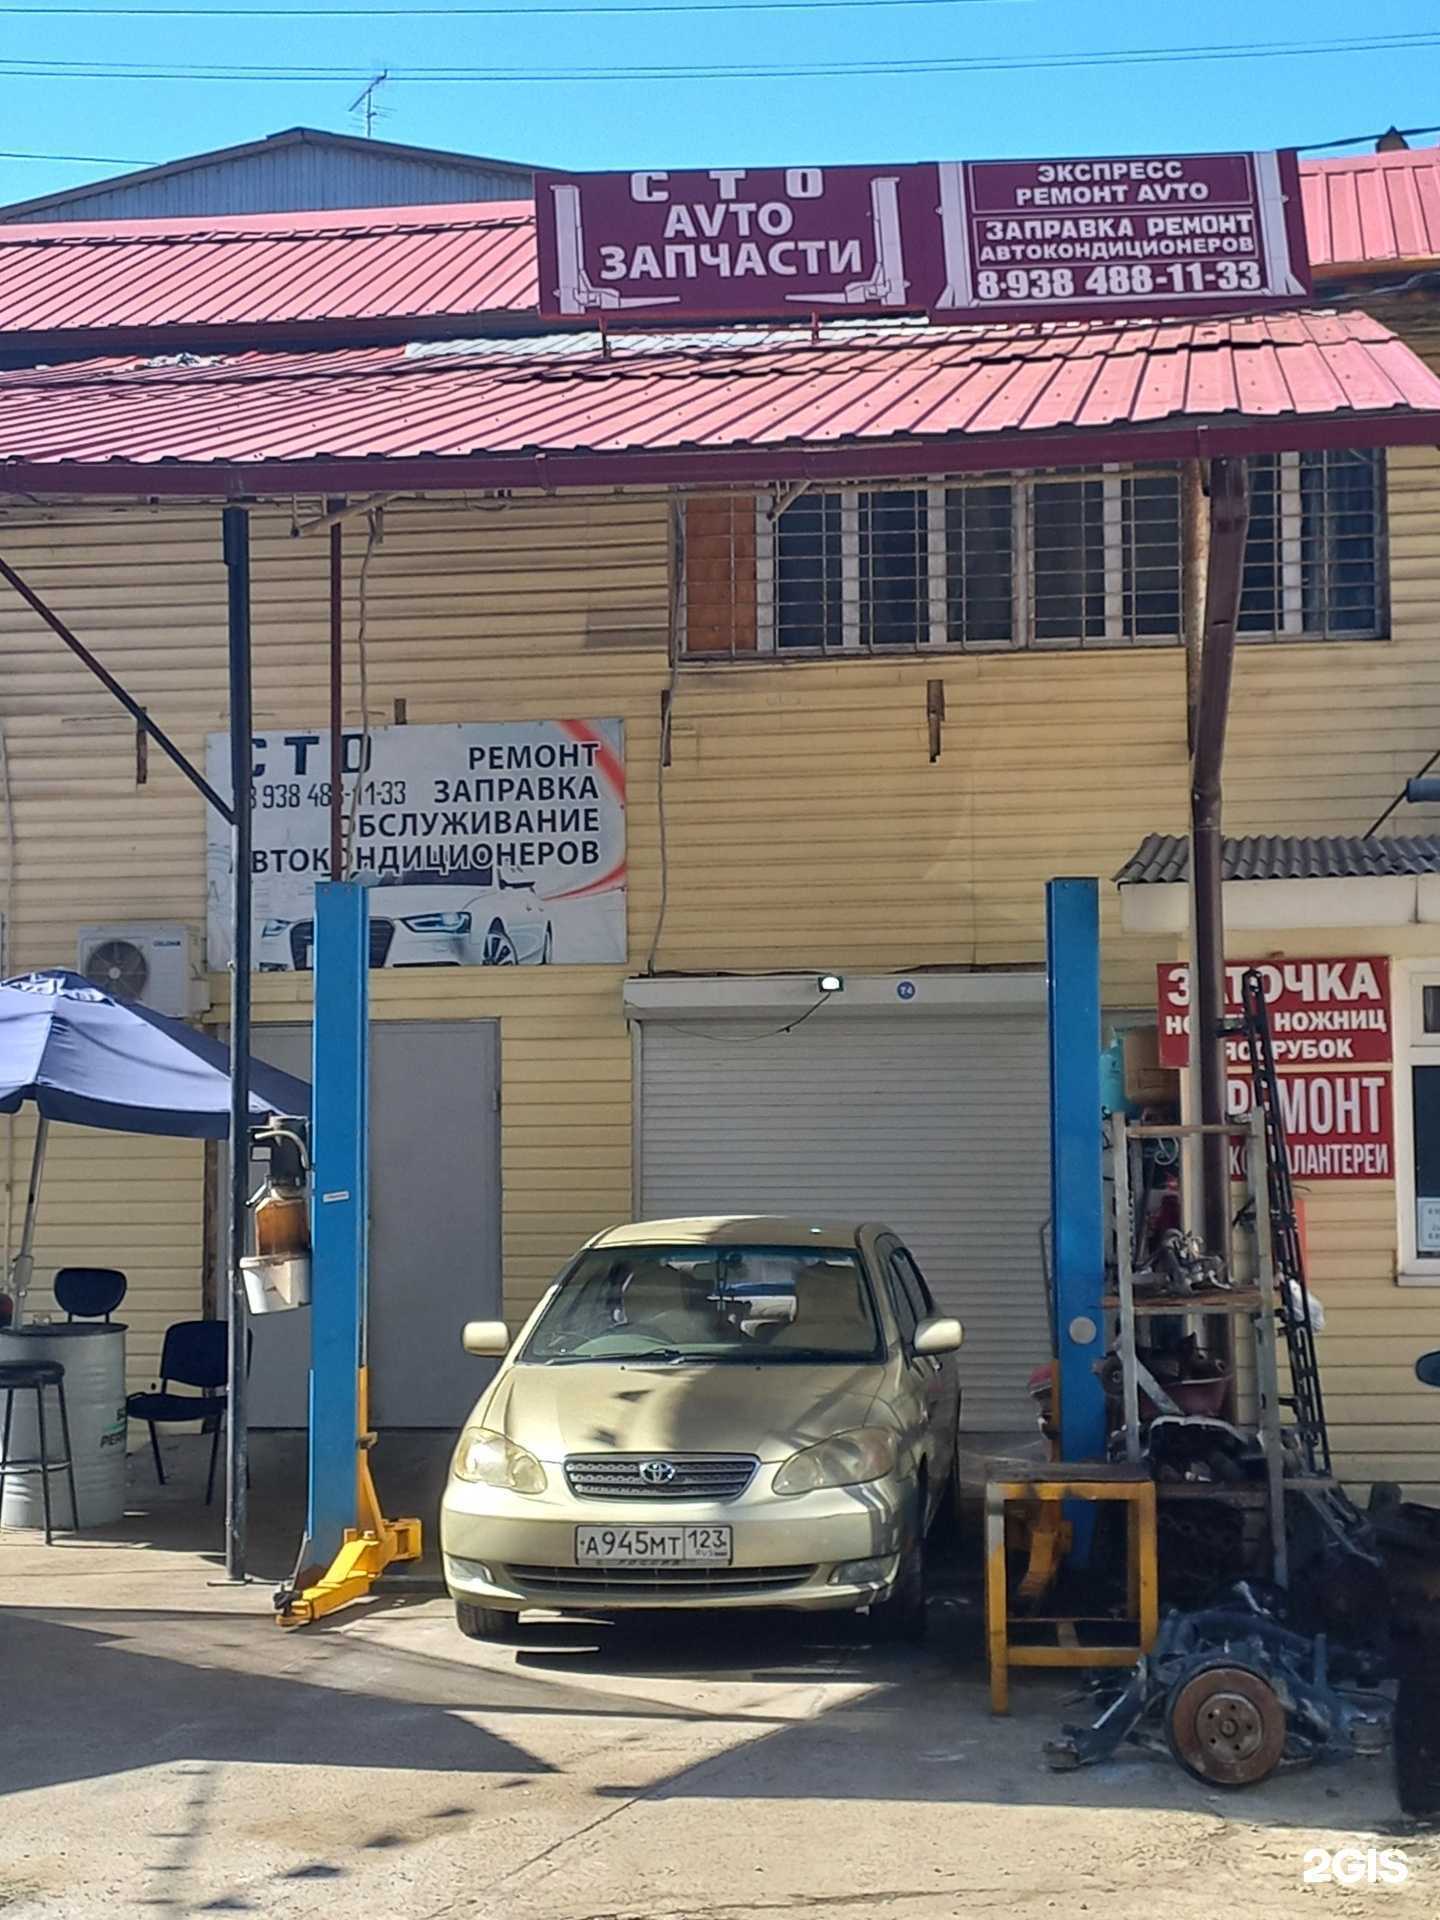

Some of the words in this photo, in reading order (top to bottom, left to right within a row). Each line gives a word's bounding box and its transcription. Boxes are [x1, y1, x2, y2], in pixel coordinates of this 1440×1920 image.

[1037, 160, 1183, 184] ЭКСПРЕСС
[1016, 184, 1129, 207] РЕМОНТ
[1137, 182, 1209, 202] AVTO
[664, 202, 793, 239] AVTO
[985, 216, 1135, 241] ЗАПРАВКА
[1148, 213, 1253, 238] РЕМОНТ
[600, 239, 863, 280] ЗАПЧАСТИ
[980, 237, 1255, 262] АВТОКОНДИЦИОНЕРОВ
[1085, 261, 1261, 296] 488-11-33
[468, 742, 600, 771] РЕМОНТ
[262, 784, 300, 808] 938
[307, 780, 407, 807] 48-11-33
[433, 775, 600, 804] ЗАПРАВКА
[1167, 961, 1382, 1007] ЗТОЧКА
[1274, 1009, 1388, 1033] НОЖНИЦ
[1227, 1077, 1385, 1135] РМОНТ
[586, 1530, 681, 1555] А945МТ
[688, 1529, 724, 1549] 123
